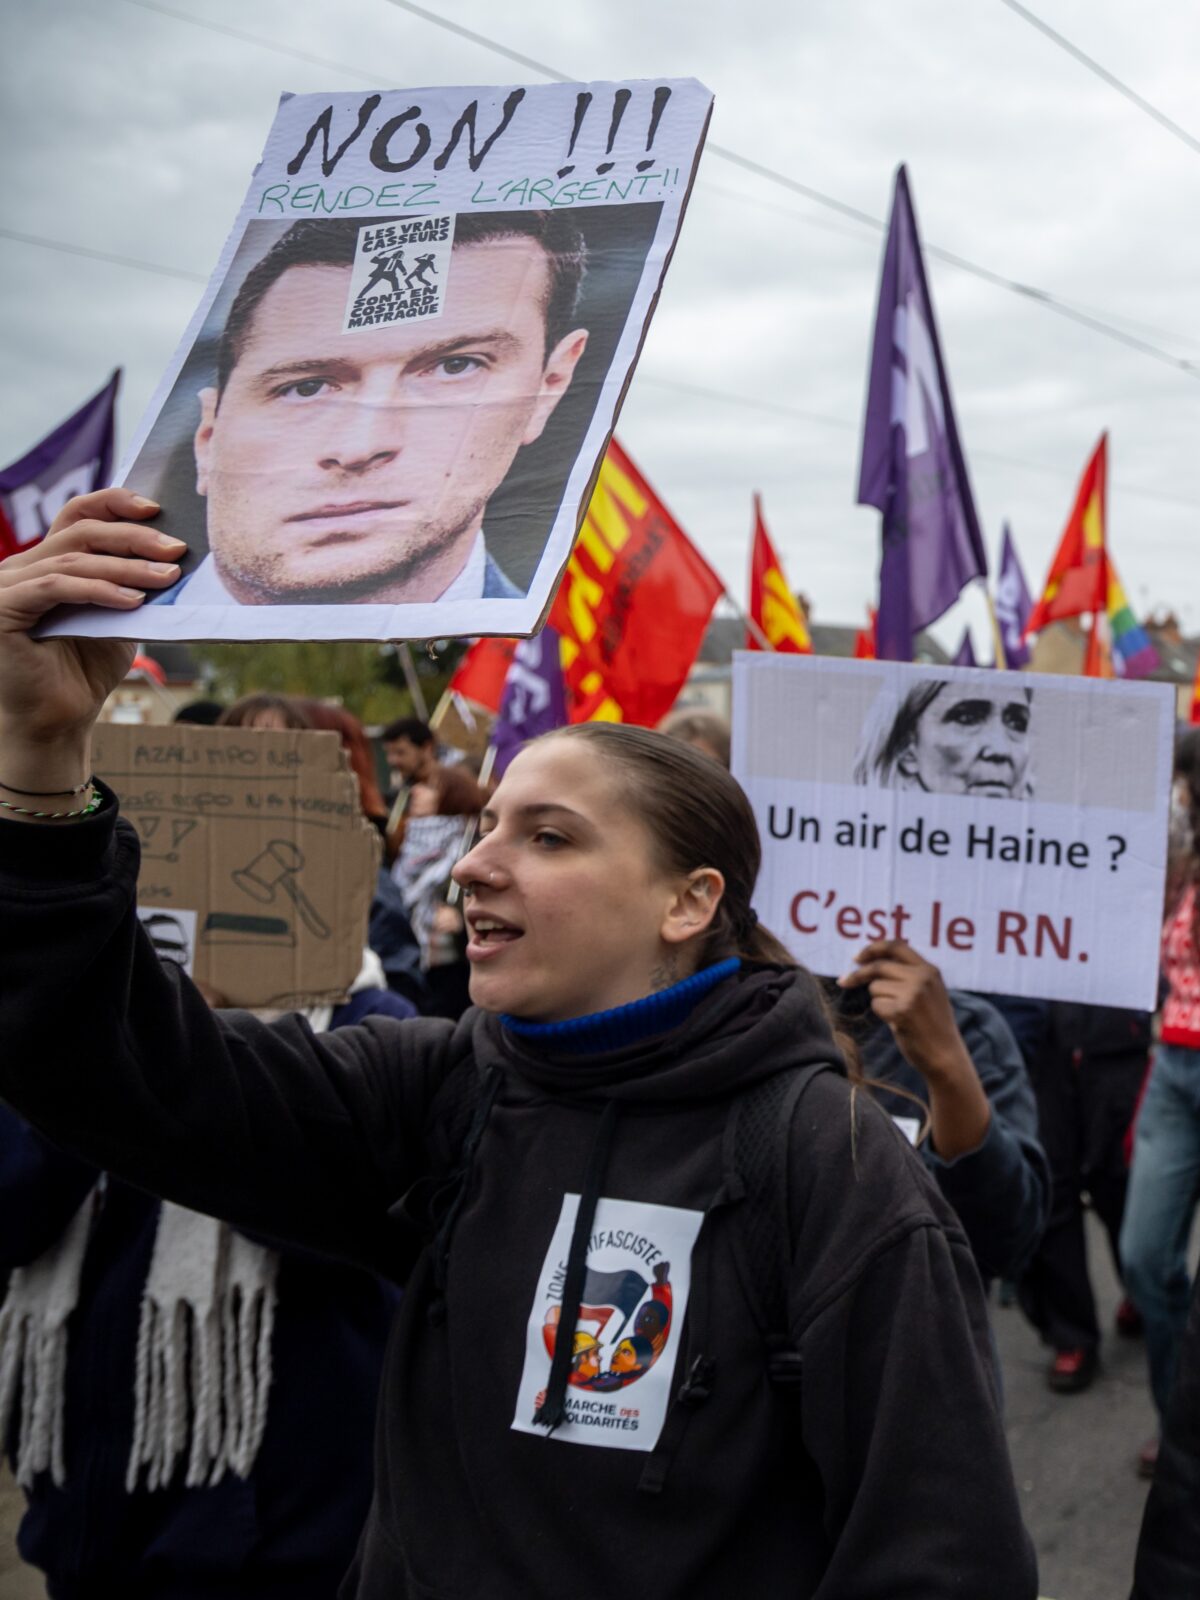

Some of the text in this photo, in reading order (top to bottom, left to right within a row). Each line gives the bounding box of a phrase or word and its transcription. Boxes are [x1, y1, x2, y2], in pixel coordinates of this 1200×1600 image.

[286, 86, 672, 178] NON !!!
[258, 182, 441, 214] RENDEZ
[362, 228, 449, 253] CASSEURS
[364, 216, 450, 242] LES VRAIS
[350, 296, 440, 318] COSTARD-
[353, 285, 438, 309] SONT EN
[347, 303, 439, 329] MATRAQUE
[768, 805, 1128, 871] Un air de Haine ?
[789, 889, 1089, 963] C'est le RN.
[565, 1411, 639, 1432] OLIDARITÉS
[619, 1408, 640, 1418] DES
